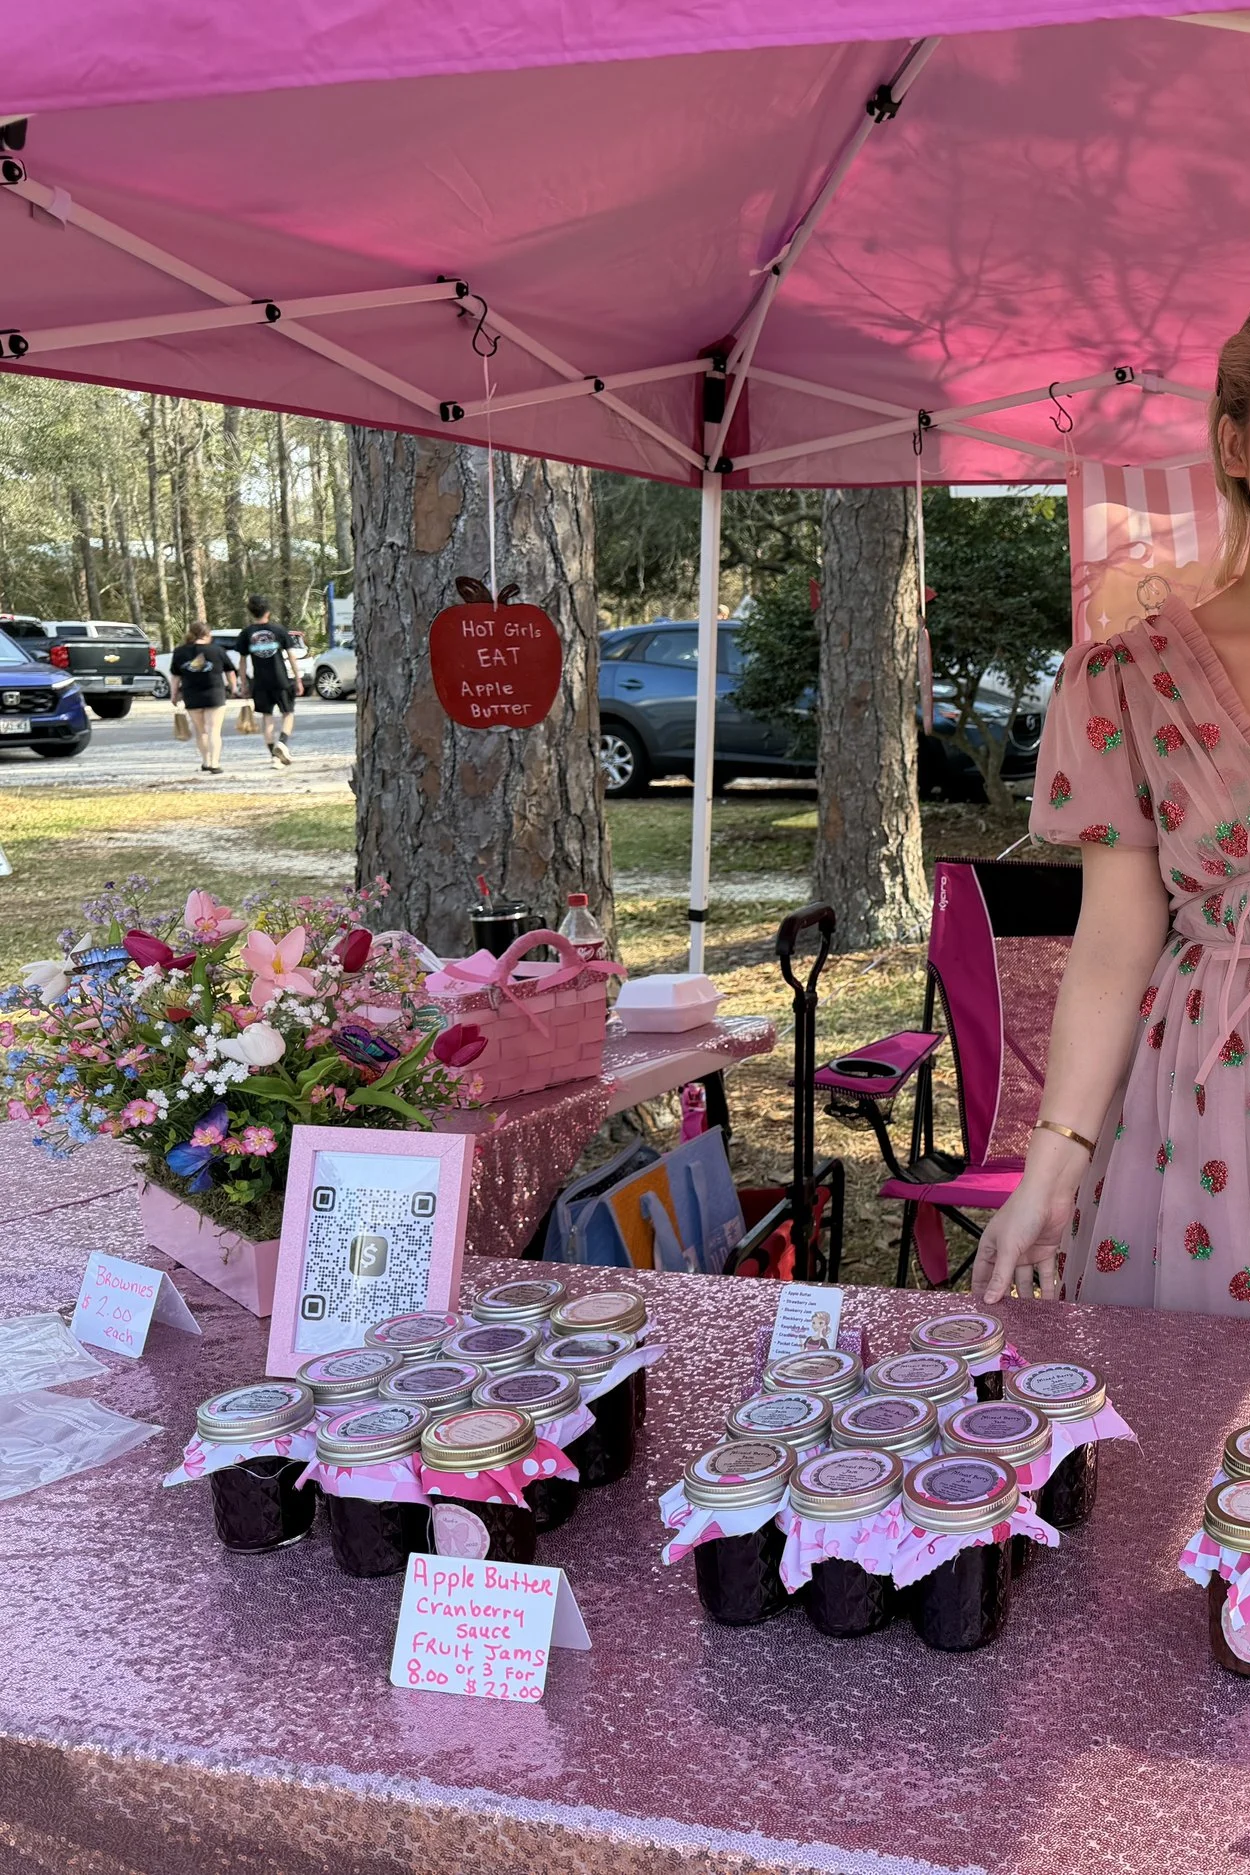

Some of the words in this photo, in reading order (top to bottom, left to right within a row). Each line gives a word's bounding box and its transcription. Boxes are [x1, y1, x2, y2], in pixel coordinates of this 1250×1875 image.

[504, 623, 541, 639] Girls
[478, 647, 520, 668] EAT
[461, 681, 514, 696] Apple
[96, 1296, 132, 1322] 2.00
[104, 1327, 133, 1346] each
[951, 1470, 971, 1478] Mixed
[973, 1475, 989, 1483] Berry
[414, 1558, 475, 1597] Apple
[416, 1597, 525, 1628] Cranberry
[484, 1644, 545, 1667] Jams
[407, 1658, 449, 1685] 8.00
[455, 1664, 474, 1675] or
[483, 1663, 493, 1677] 3
[484, 1681, 544, 1699] 22.00
